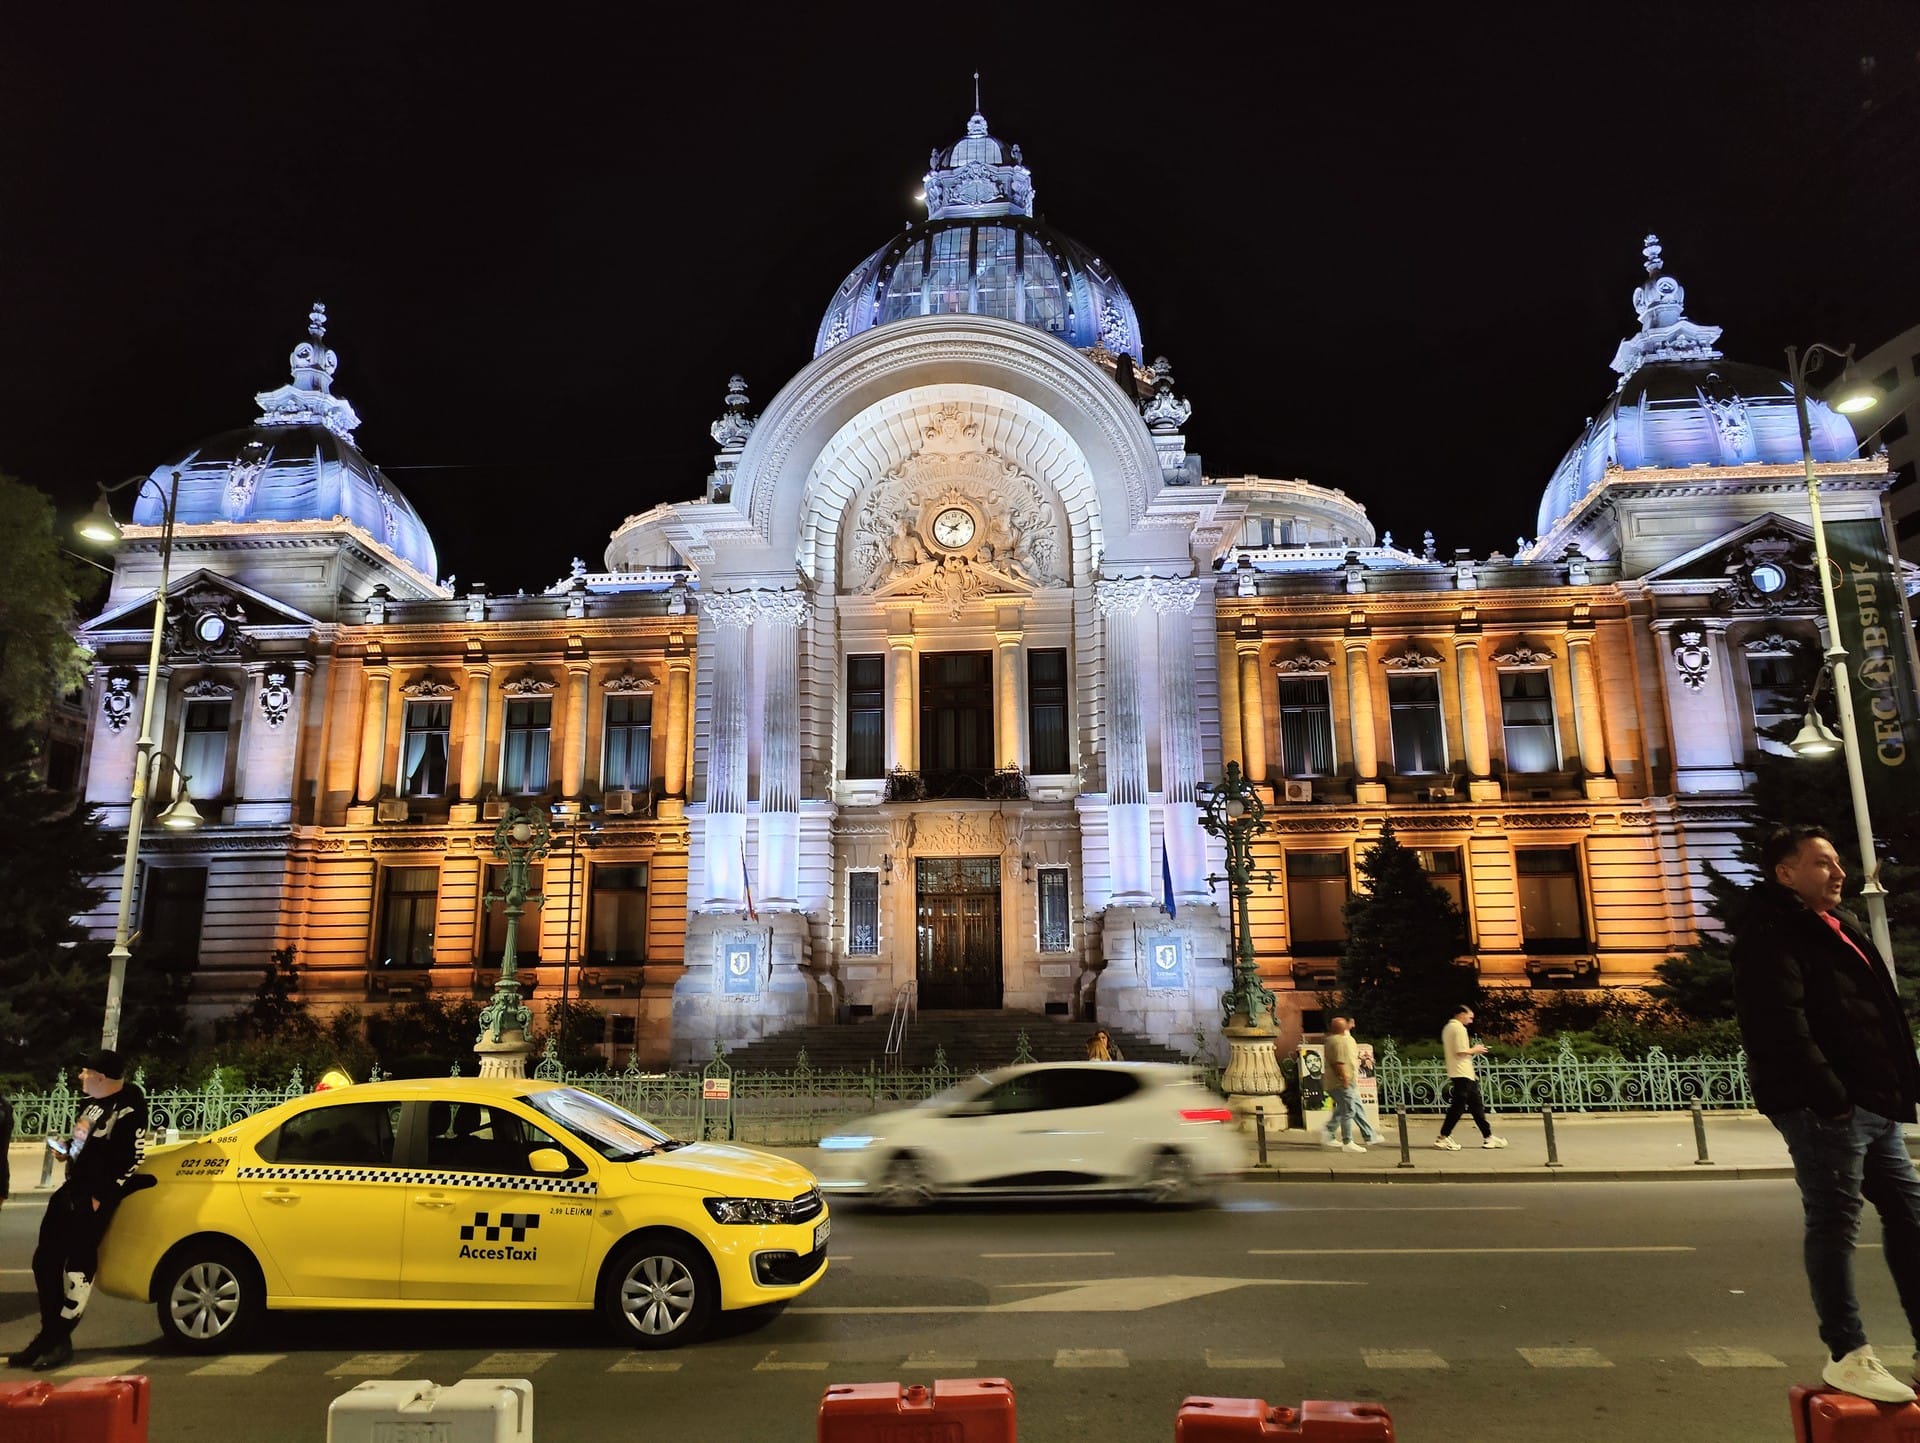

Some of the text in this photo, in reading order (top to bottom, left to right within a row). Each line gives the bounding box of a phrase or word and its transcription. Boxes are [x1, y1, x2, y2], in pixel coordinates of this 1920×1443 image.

[1871, 697, 1906, 767] CEC
[181, 1158, 231, 1168] 021 9621
[565, 1207, 593, 1216] LEI/KM
[459, 1244, 537, 1261] AccesTaxi
